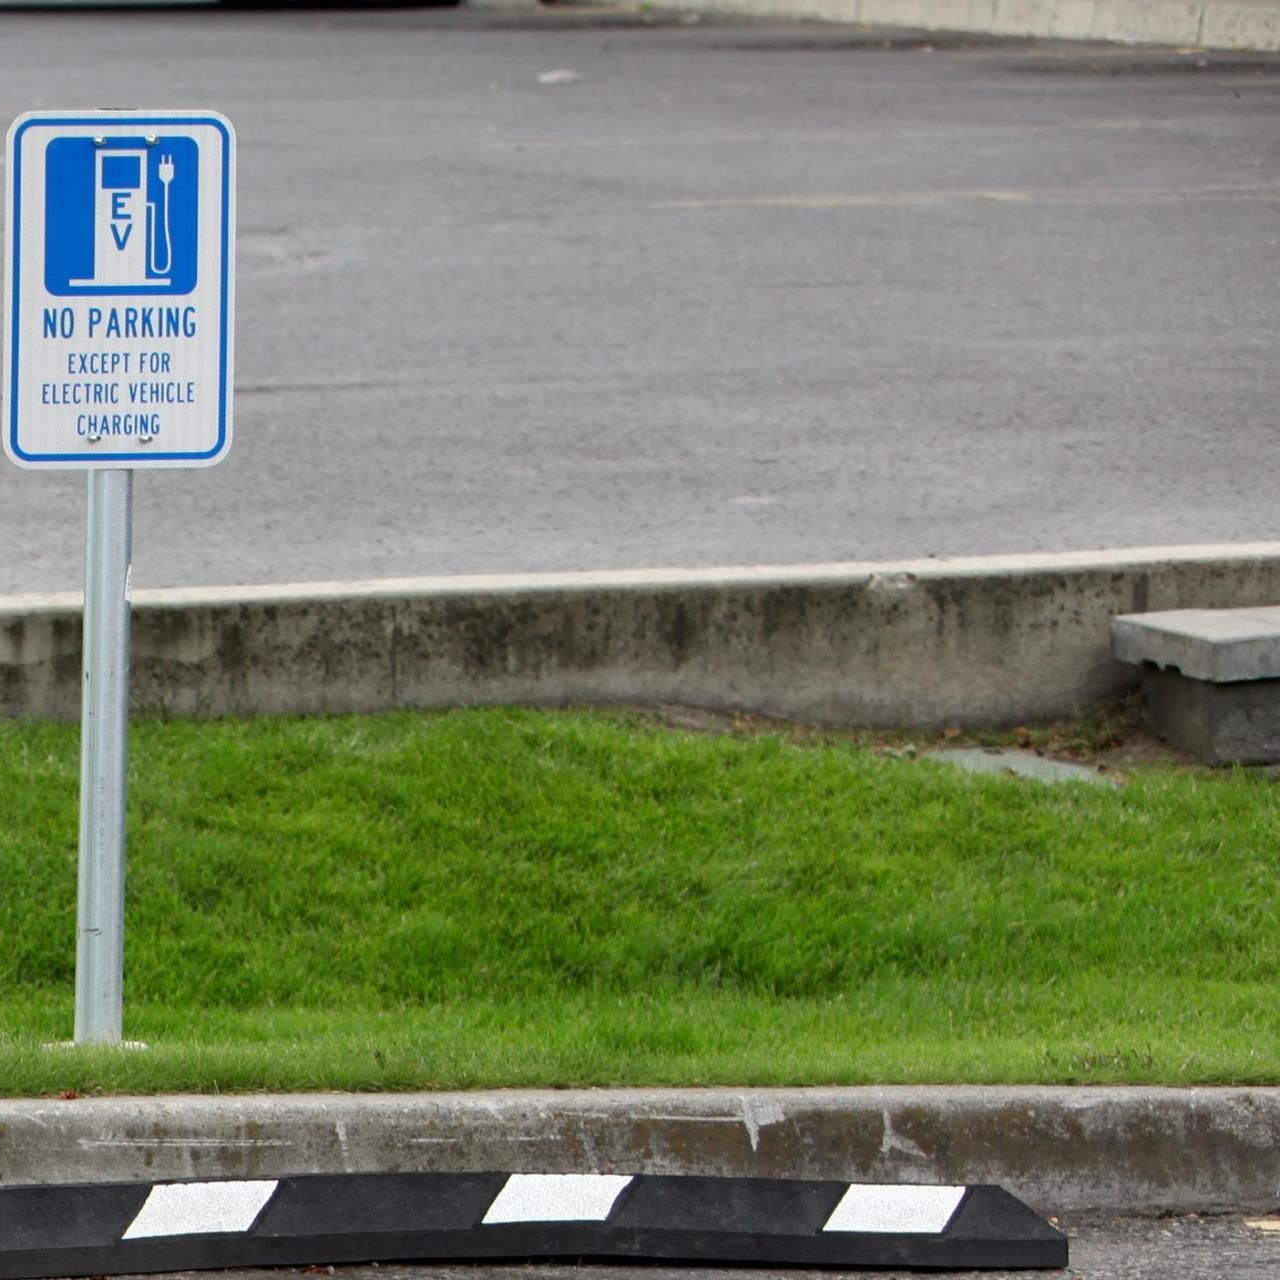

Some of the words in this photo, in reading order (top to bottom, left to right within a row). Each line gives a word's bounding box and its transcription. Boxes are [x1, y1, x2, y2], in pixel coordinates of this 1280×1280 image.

[110, 192, 133, 251] EV
[43, 307, 74, 339] NO
[88, 306, 197, 338] PARKING
[68, 353, 130, 374] EXCEPT
[140, 352, 171, 373] FOR
[42, 383, 119, 404] ELECTRIC
[129, 382, 195, 403] VEHICLE
[77, 414, 160, 436] CHARGING
